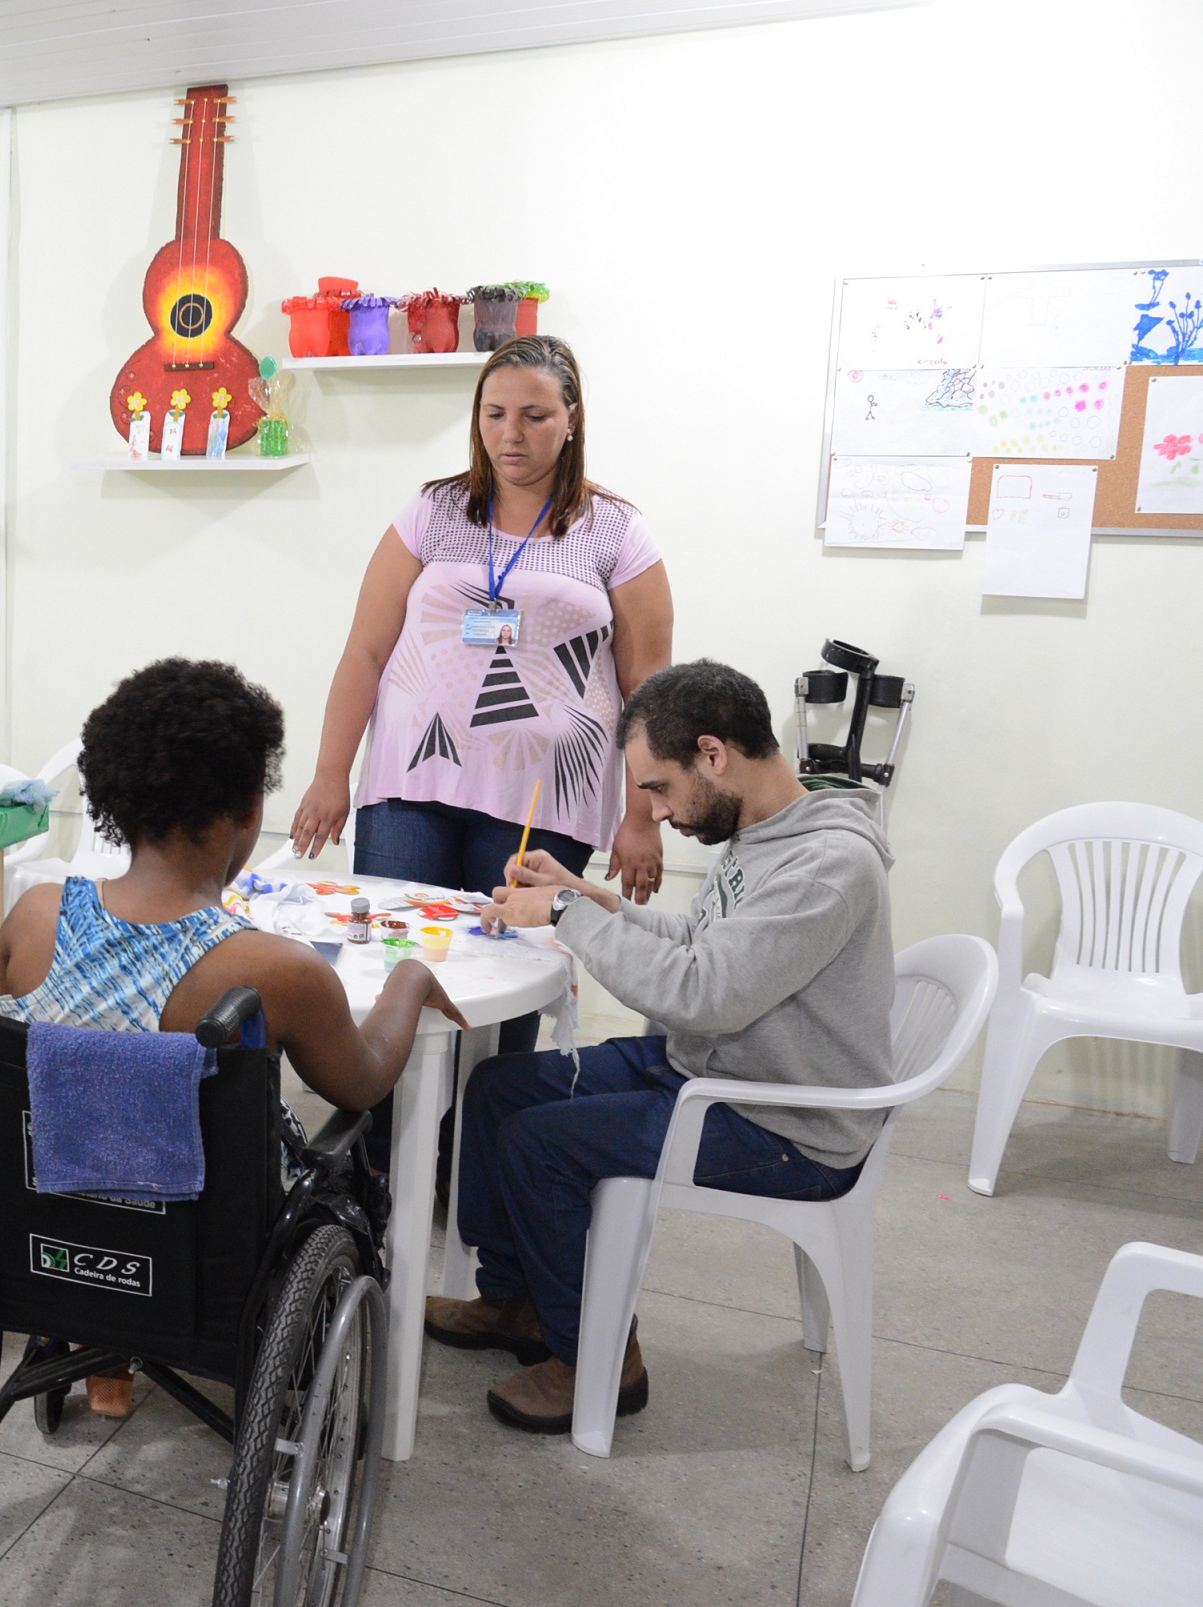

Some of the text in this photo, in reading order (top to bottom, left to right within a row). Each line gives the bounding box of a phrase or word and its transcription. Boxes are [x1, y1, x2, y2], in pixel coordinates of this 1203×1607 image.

[74, 1267, 141, 1288] Cadeira de rodas
